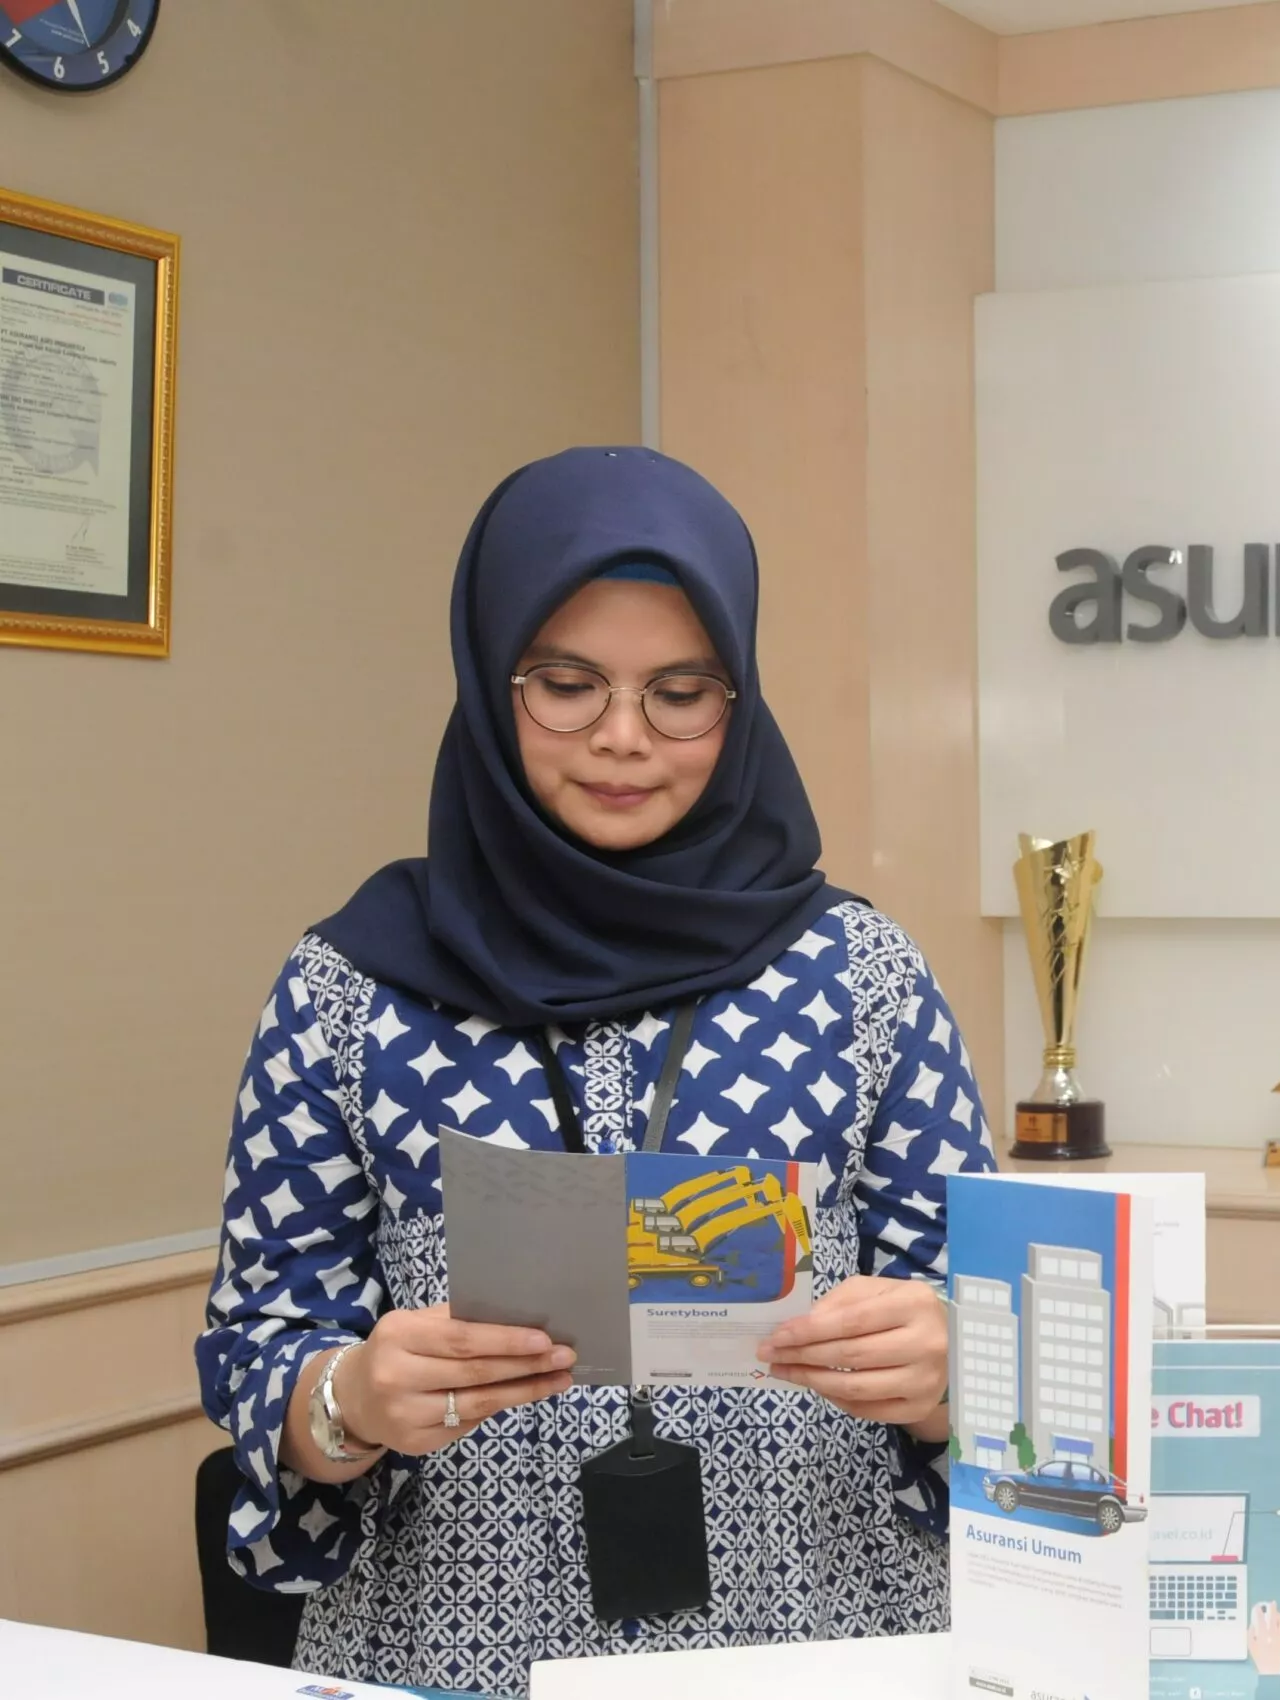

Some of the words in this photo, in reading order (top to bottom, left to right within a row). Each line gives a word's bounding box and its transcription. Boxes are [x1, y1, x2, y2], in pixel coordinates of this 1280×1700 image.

[5, 27, 22, 48] 7
[126, 18, 142, 38] 4
[53, 56, 66, 79] 6
[96, 50, 110, 75] 5
[17, 274, 92, 301] CERTIFICATE
[647, 1308, 728, 1319] Suretybond
[1168, 1401, 1243, 1429] Chat!
[966, 1524, 1028, 1552] Asuransi
[1032, 1539, 1082, 1564] Umum
[1152, 1528, 1213, 1541] asei.co.id
